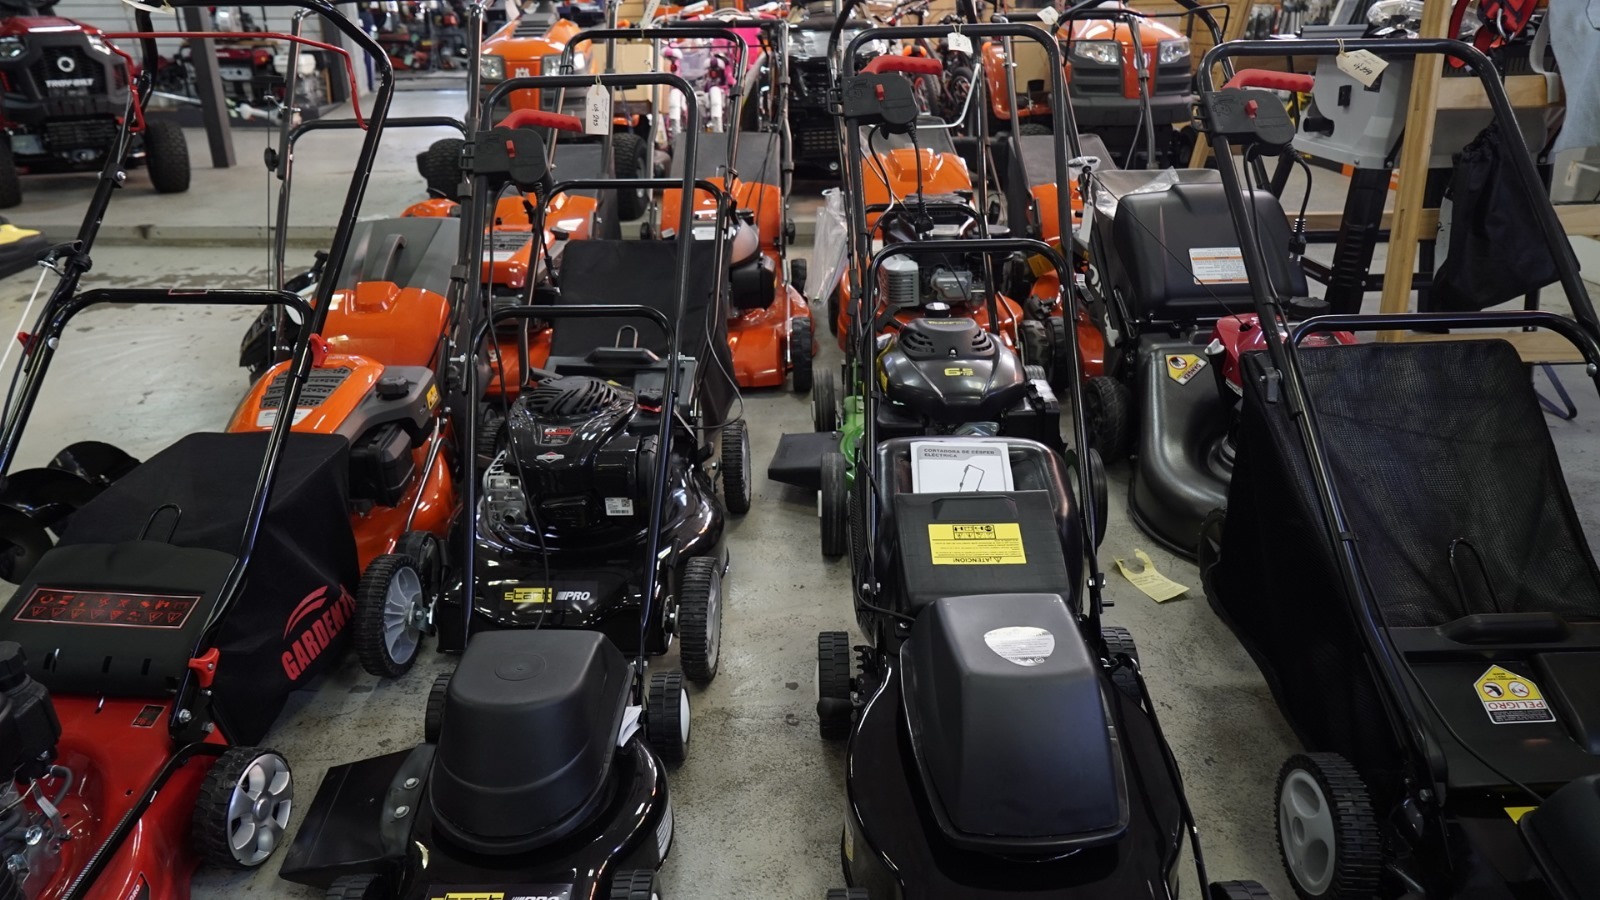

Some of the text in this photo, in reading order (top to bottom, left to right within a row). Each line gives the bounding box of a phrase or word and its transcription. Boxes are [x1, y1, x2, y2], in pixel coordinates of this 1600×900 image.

[1183, 363, 1202, 380] DANGER
[564, 591, 591, 601] PRO
[1488, 702, 1544, 710] PELIGRO
